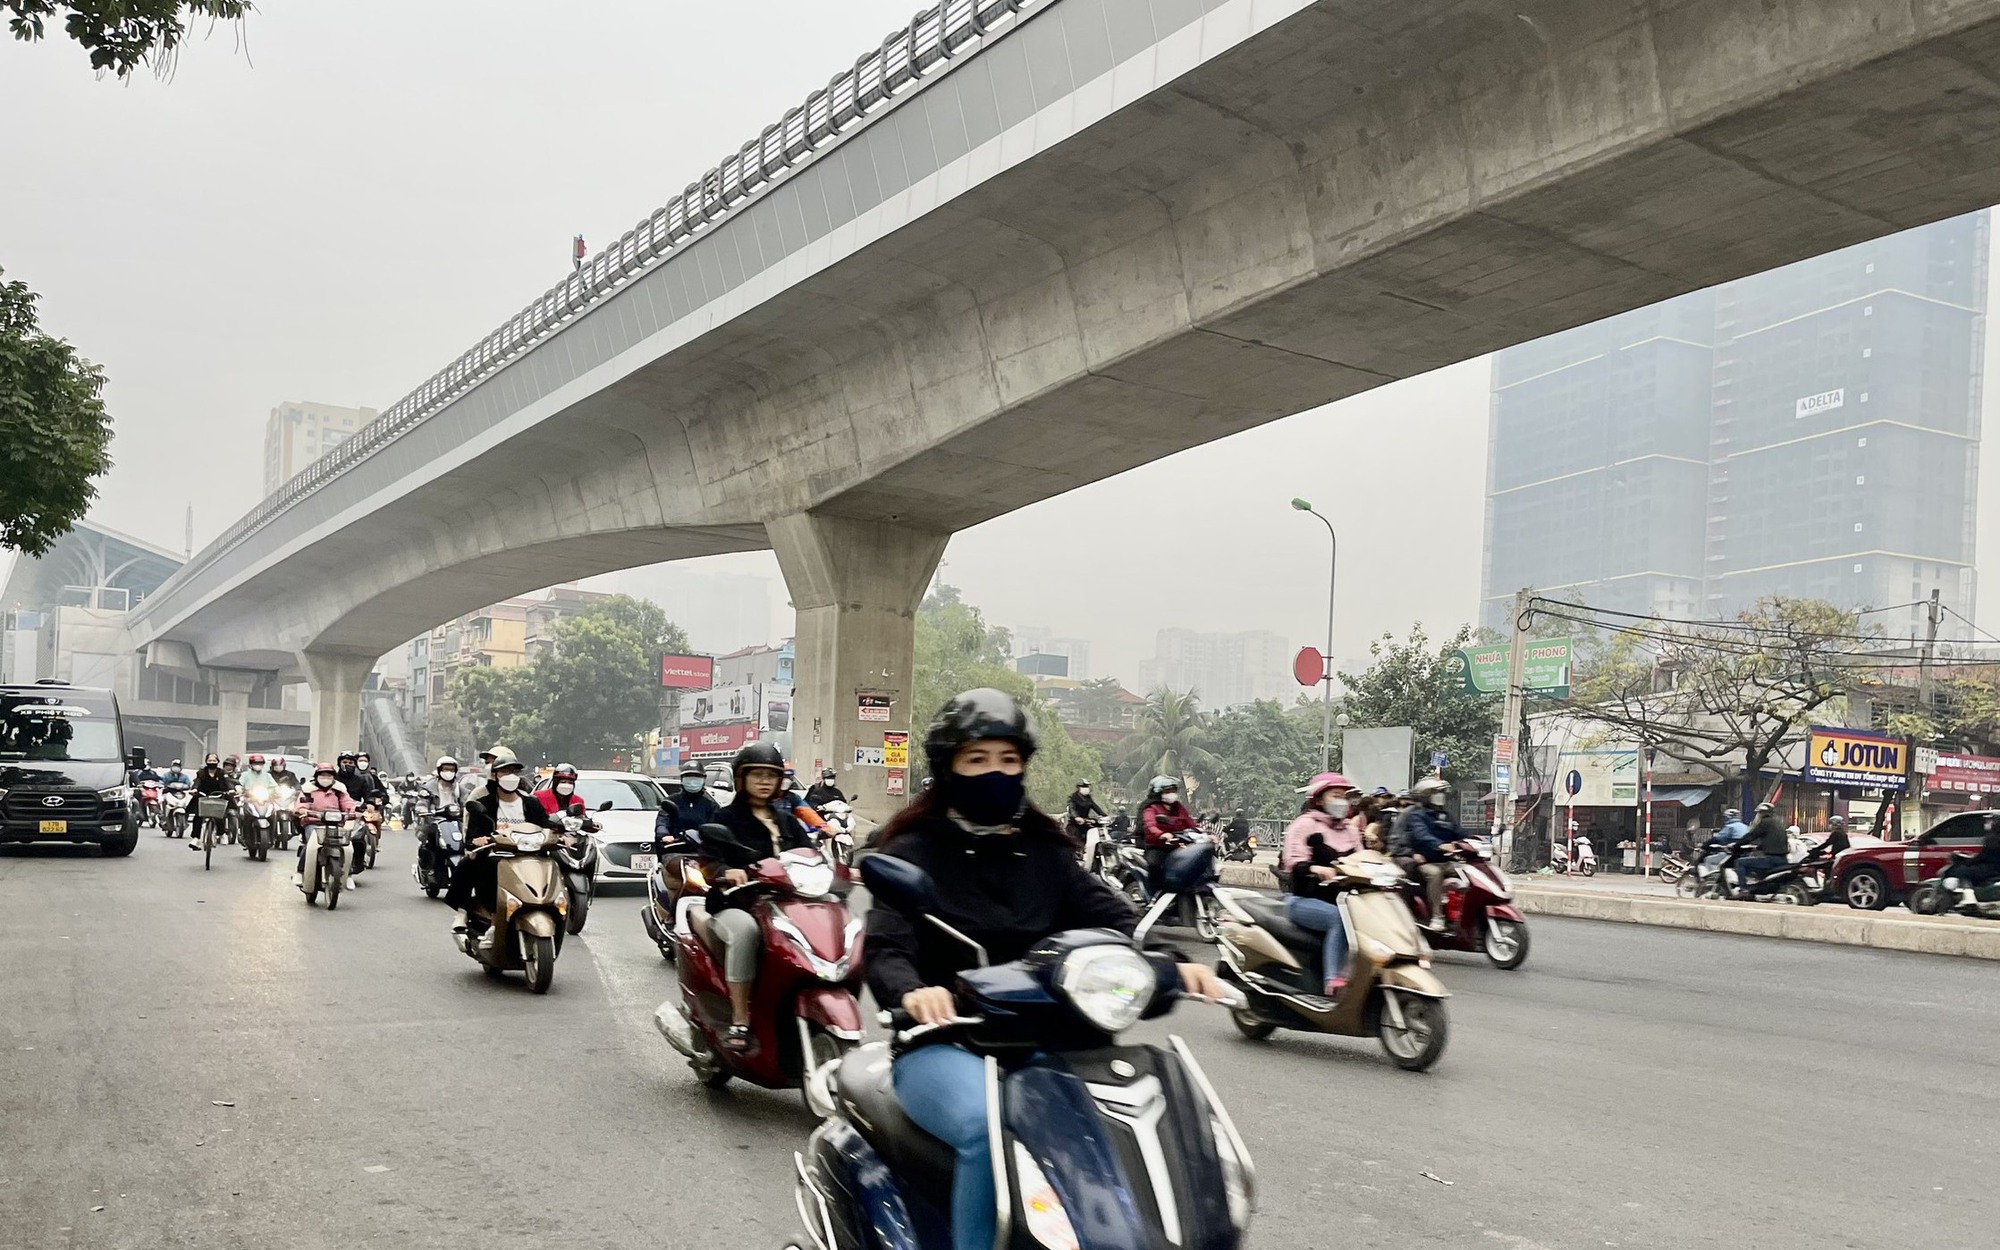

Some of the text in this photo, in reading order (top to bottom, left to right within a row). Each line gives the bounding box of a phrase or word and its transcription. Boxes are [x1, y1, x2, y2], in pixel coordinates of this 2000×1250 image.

[1808, 392, 1840, 409] DELTA
[1531, 646, 1568, 660] PHONG
[664, 668, 693, 677] viettel
[701, 732, 718, 746] viettel
[1840, 742, 1899, 769] JOTUN
